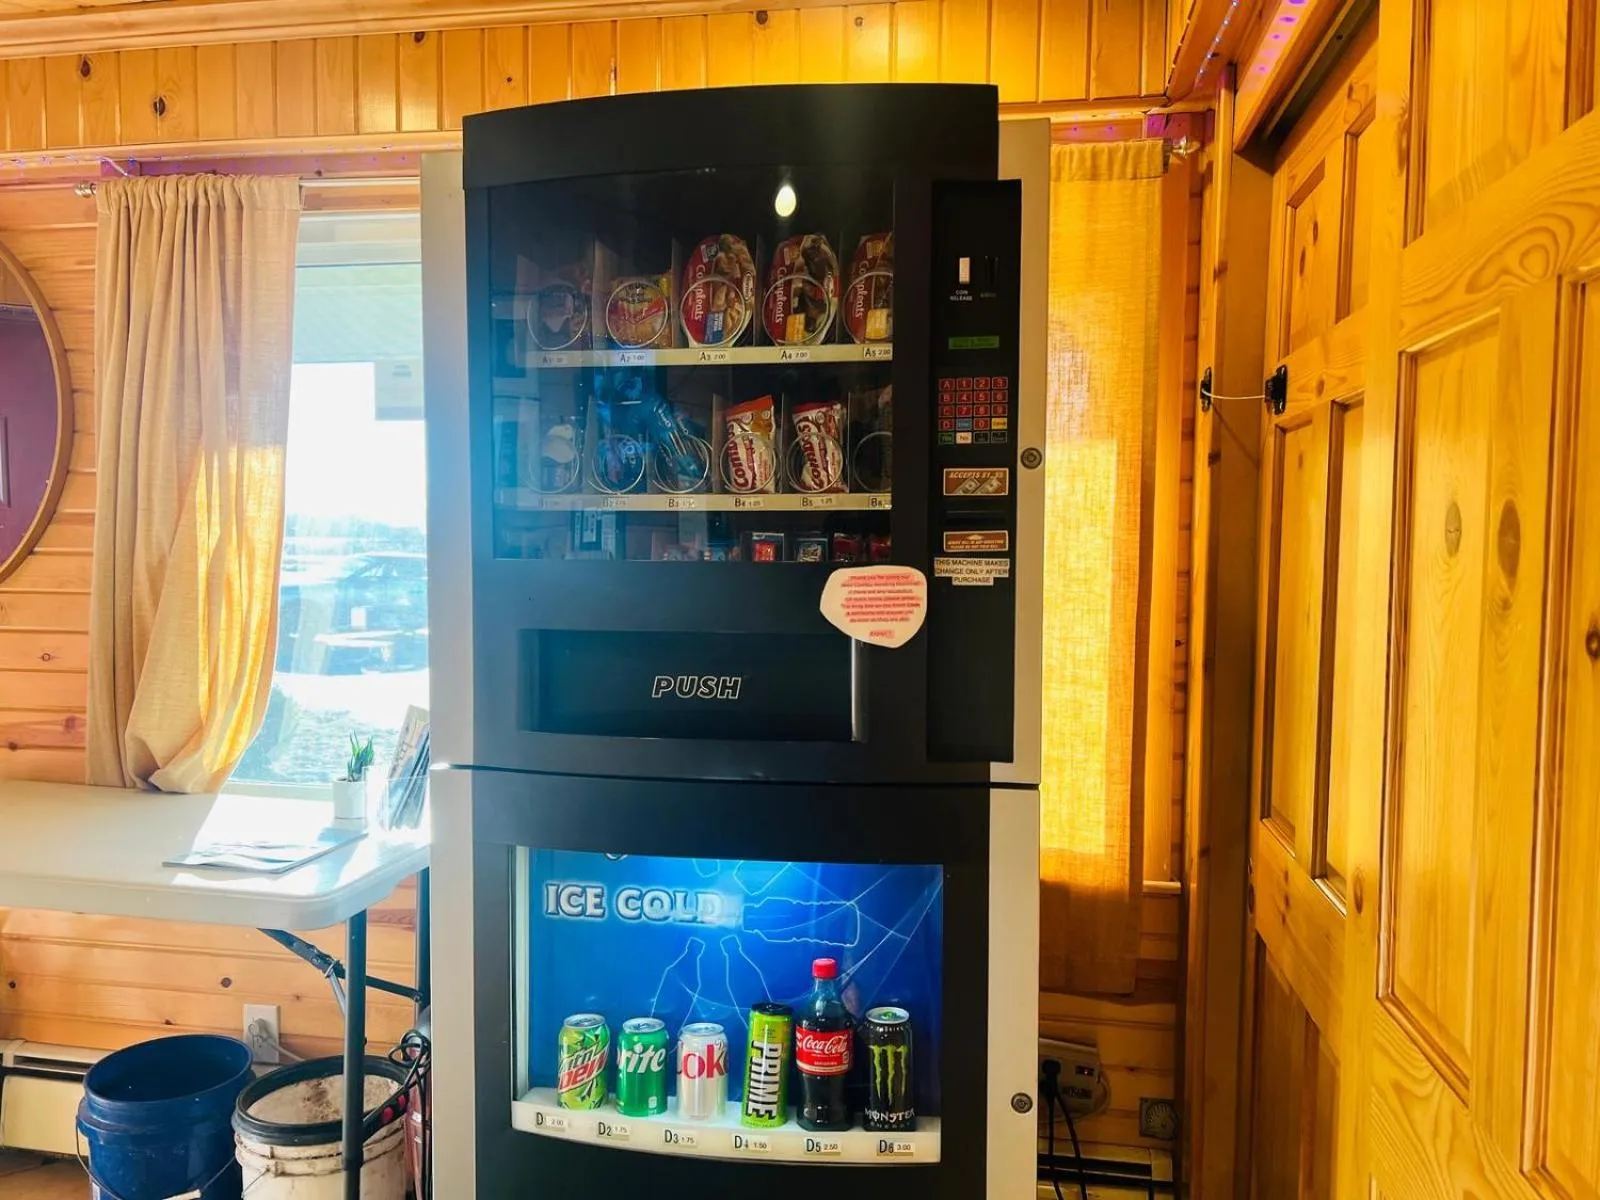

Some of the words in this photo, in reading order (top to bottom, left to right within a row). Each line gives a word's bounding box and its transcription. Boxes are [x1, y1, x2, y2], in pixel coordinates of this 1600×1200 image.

[694, 264, 706, 320] Copleats
[949, 471, 981, 479] ACCEPTS
[652, 676, 742, 699] PUSH
[546, 883, 606, 918] ICE
[616, 887, 725, 925] COLD
[802, 1034, 848, 1055] Coca-Cola
[677, 1043, 729, 1080] ok
[747, 1040, 783, 1120] PRIME
[864, 1108, 916, 1124] MONSTER
[598, 1121, 612, 1137] D2
[664, 1129, 679, 1144] D3
[734, 1135, 749, 1149] D4
[806, 1138, 821, 1153] D5
[879, 1139, 894, 1154] D6
